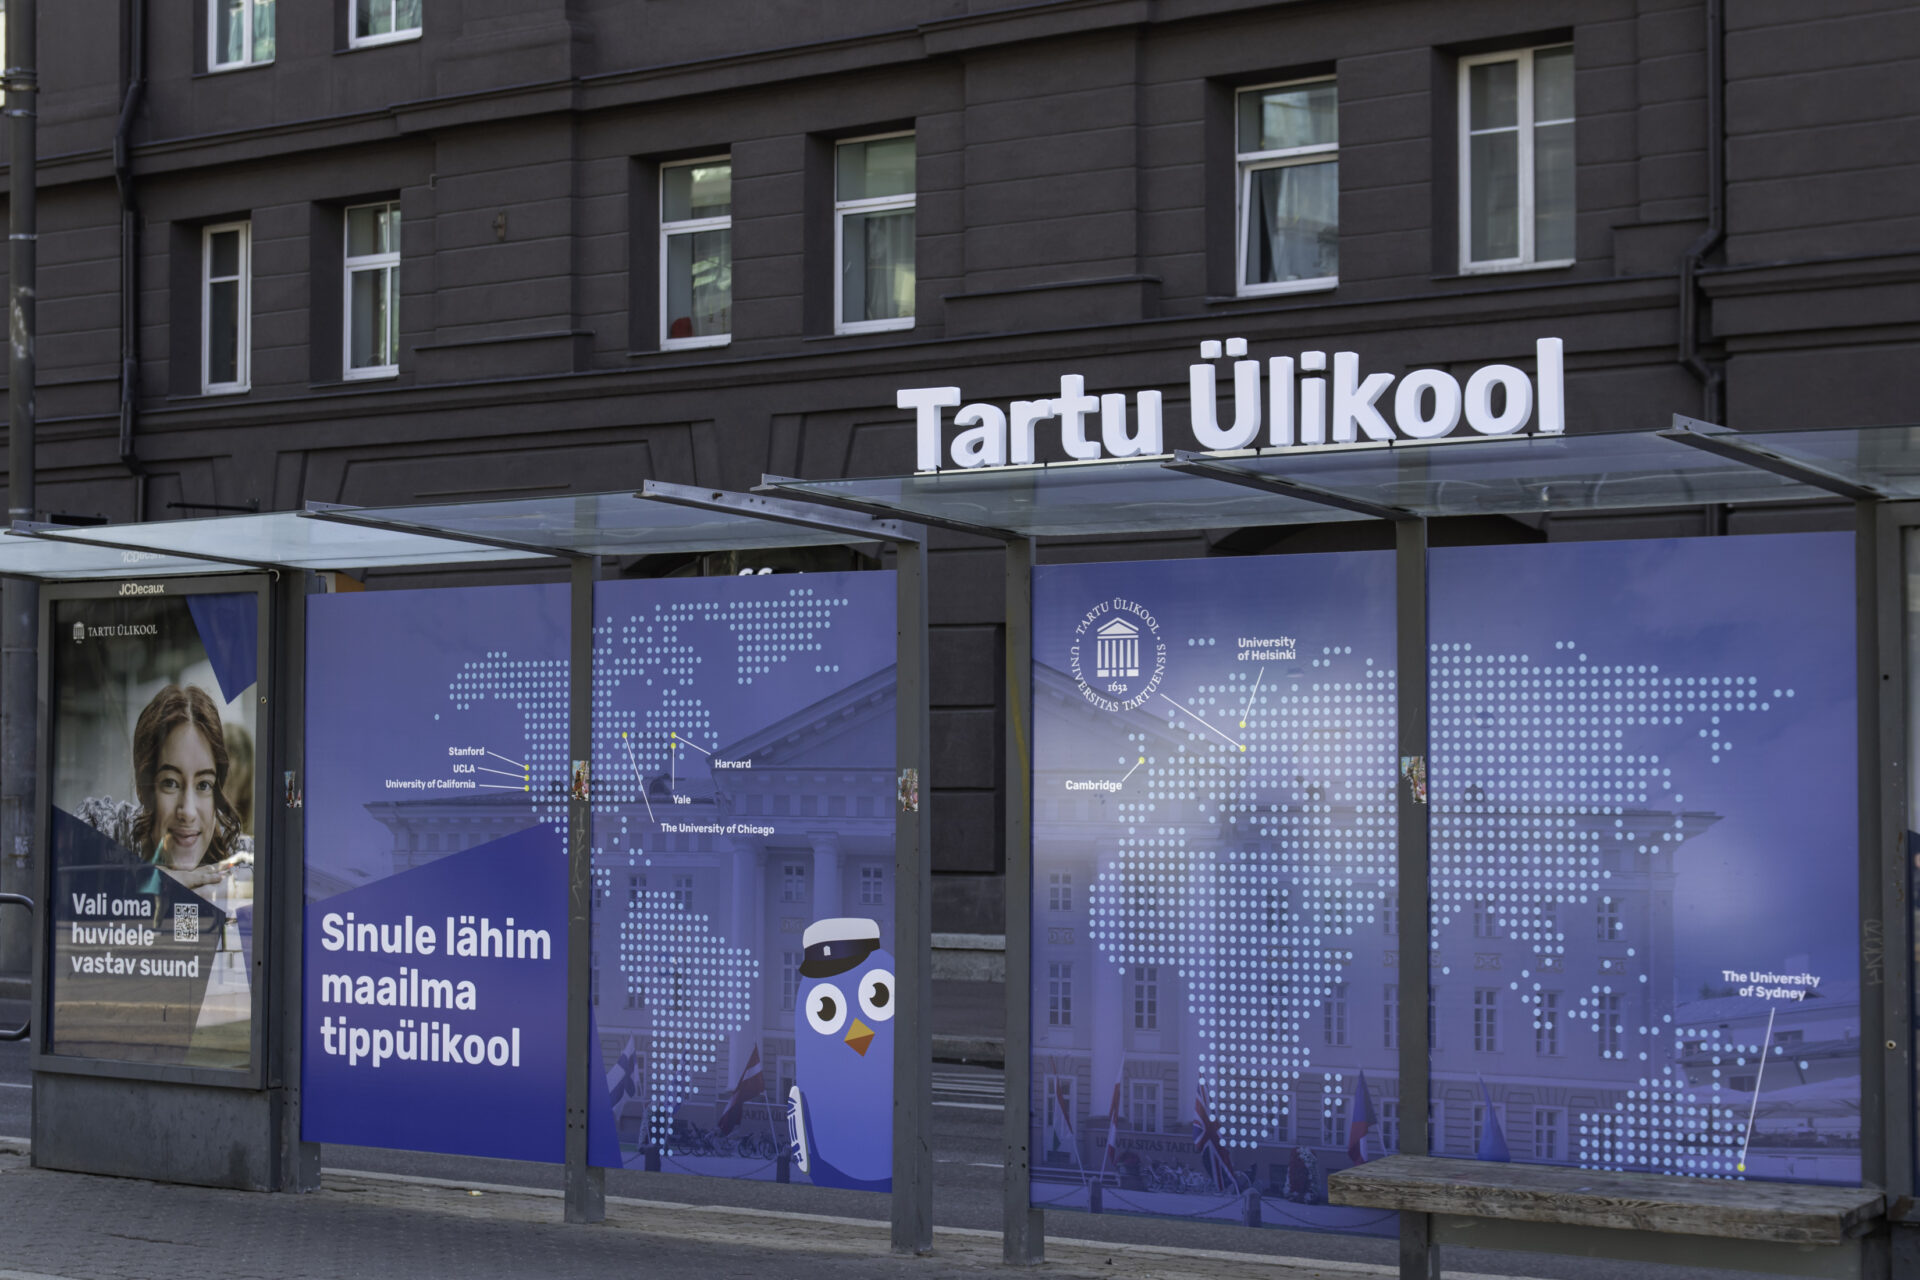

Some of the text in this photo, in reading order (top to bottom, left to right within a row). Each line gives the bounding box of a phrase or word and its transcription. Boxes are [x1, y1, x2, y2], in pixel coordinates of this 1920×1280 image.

[896, 337, 1564, 471] Tartu Ülikool
[118, 583, 165, 596] JCDecaux
[1076, 597, 1160, 635] TARTU ÜLIKOOL
[88, 624, 158, 637] TARTU ÜLIKOOL
[1238, 636, 1296, 649] University
[1237, 649, 1296, 661] of Helsinki
[1070, 643, 1167, 712] UNIVERSITAS TARTUENSIS
[1107, 681, 1128, 694] 1632
[448, 746, 485, 756] Stanford
[453, 764, 475, 773] UCLA
[715, 759, 752, 769] Harvard
[385, 779, 476, 790] University of California
[1065, 780, 1122, 793] Cambridge
[672, 795, 692, 805] Yale
[660, 823, 775, 837] The University of Chicago
[72, 893, 151, 916] Vali oma
[72, 921, 155, 947] huvidele
[321, 911, 551, 960] Sinule lähim
[71, 951, 199, 978] vastav suund
[1722, 970, 1820, 988] The University
[322, 966, 477, 1011] maailma
[1739, 985, 1807, 1002] of Sydney
[320, 1016, 520, 1068] tippülikool
